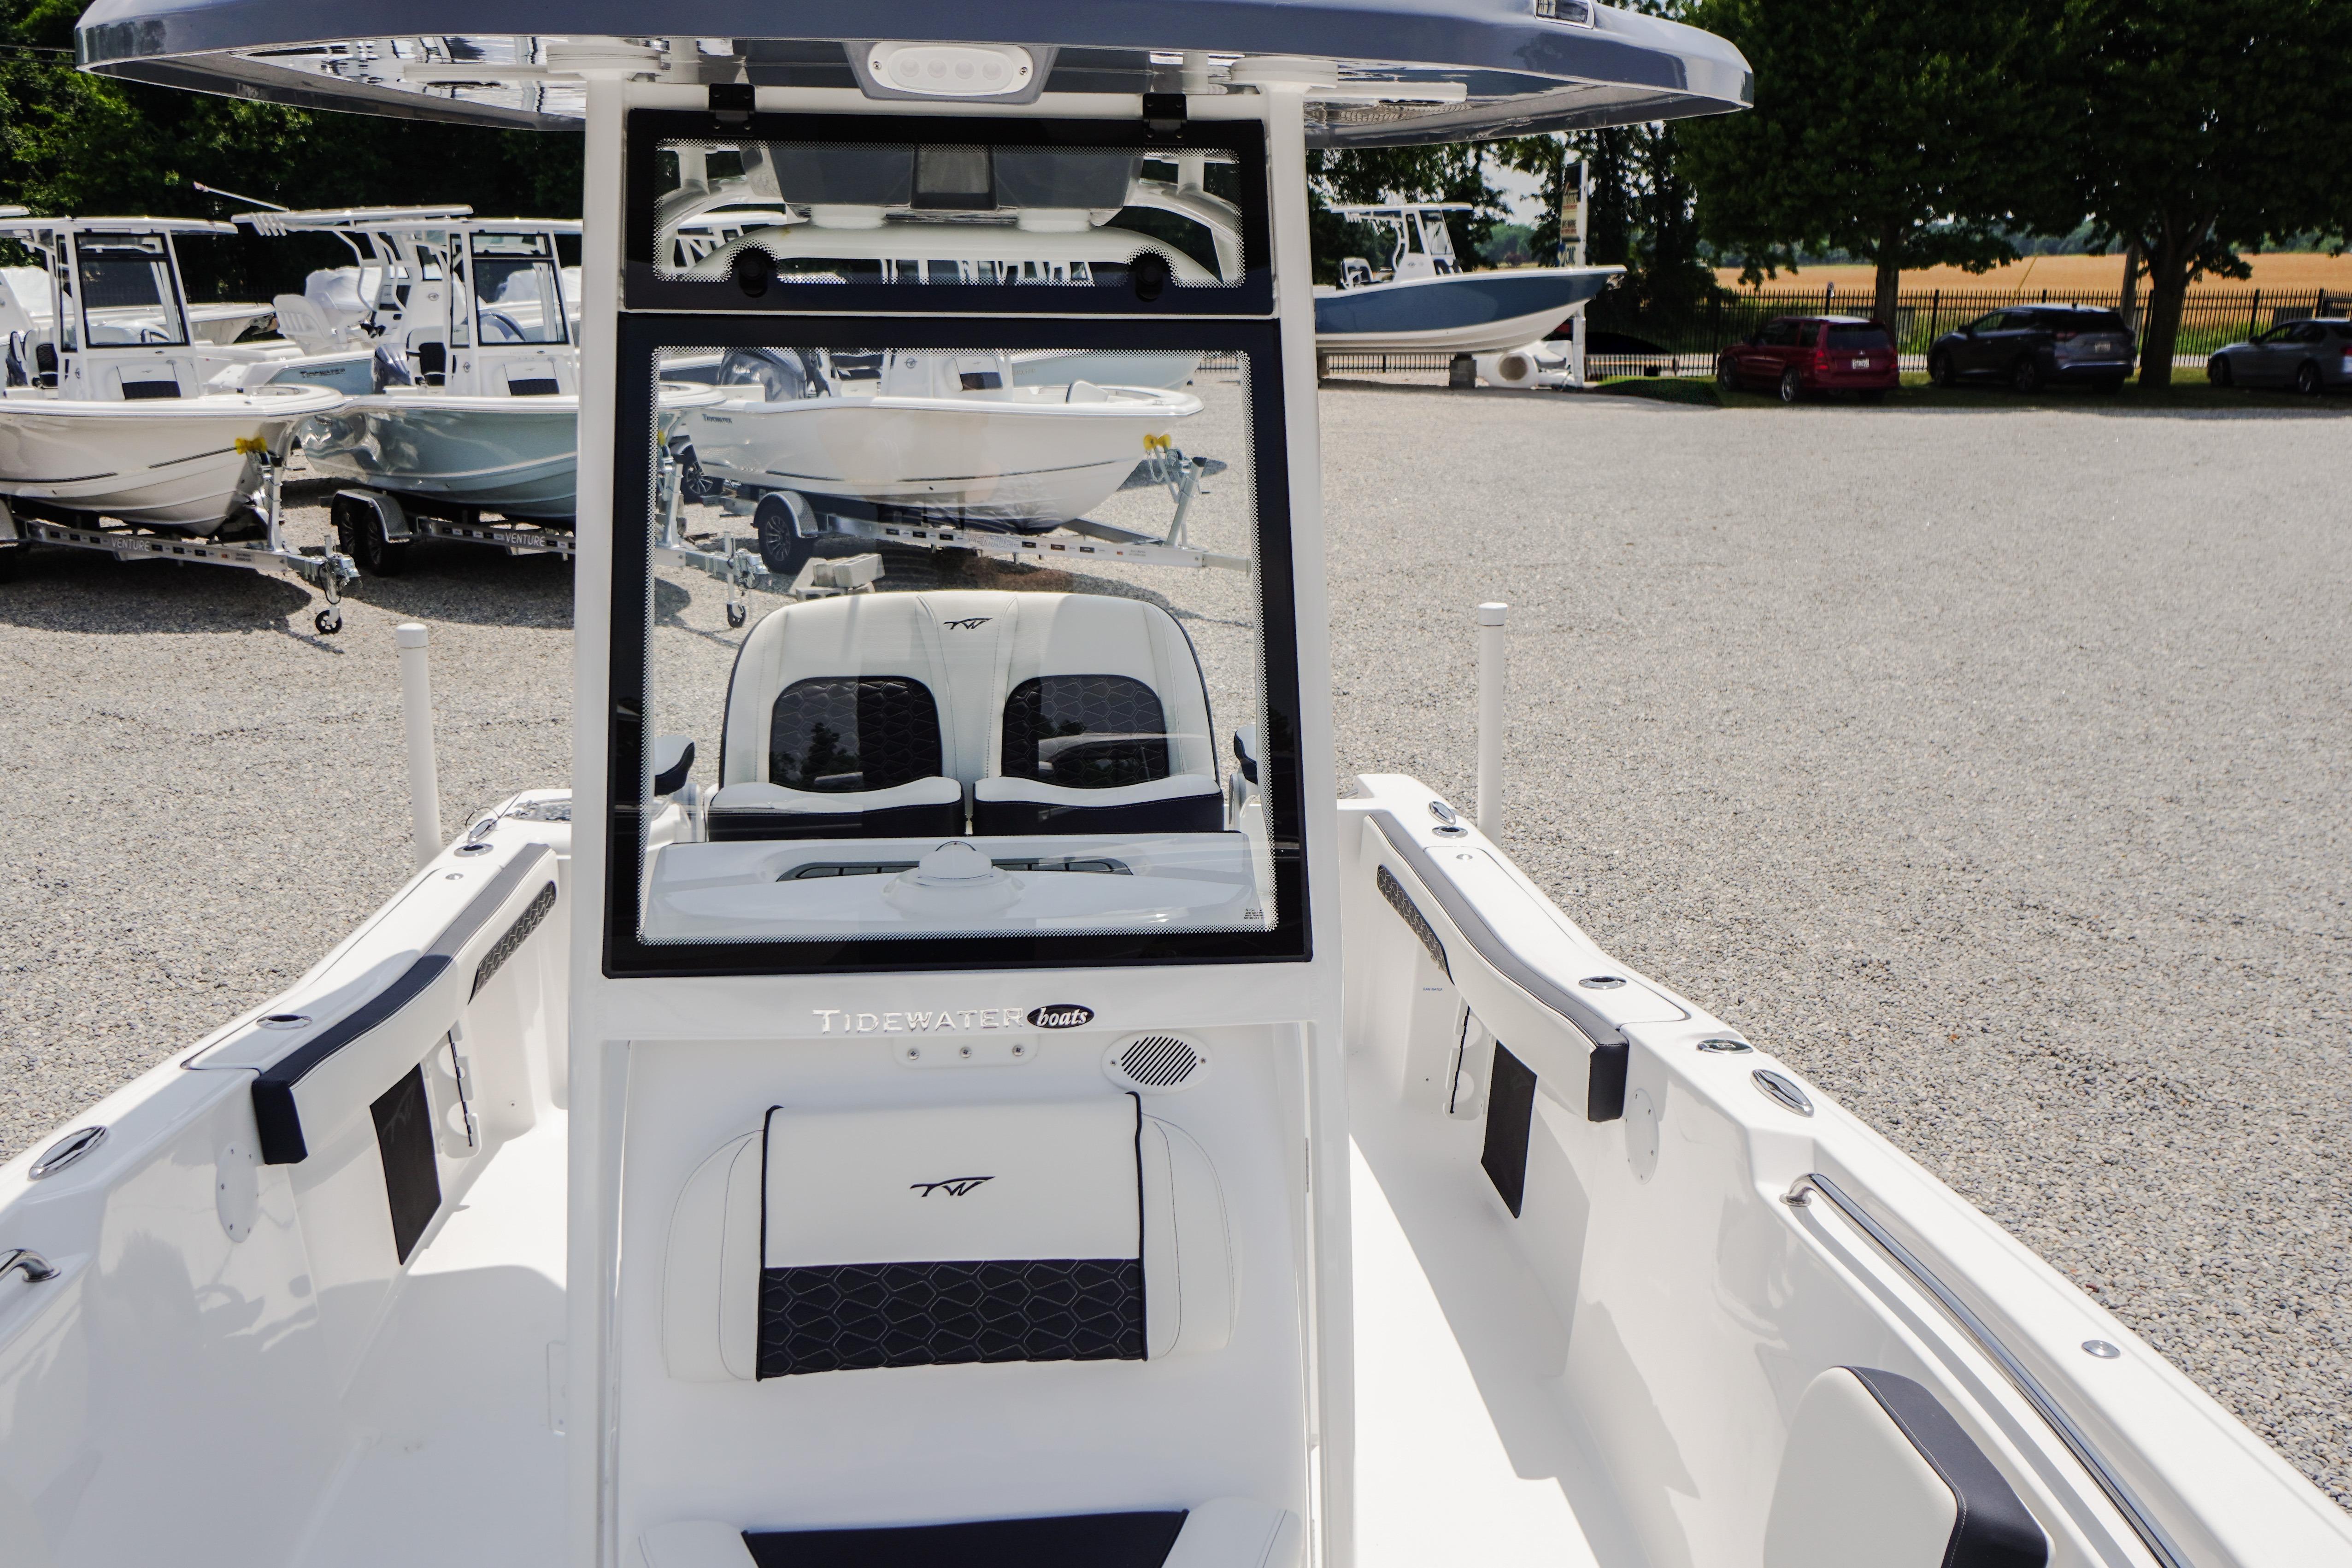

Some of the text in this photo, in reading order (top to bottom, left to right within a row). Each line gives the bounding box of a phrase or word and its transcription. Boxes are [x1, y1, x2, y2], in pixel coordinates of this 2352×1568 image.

[111, 536, 151, 552] VENTURE
[968, 533, 1022, 549] VENTURE
[811, 1006, 1088, 1035] TIDEWATER boats
[909, 1175, 996, 1197] TW
